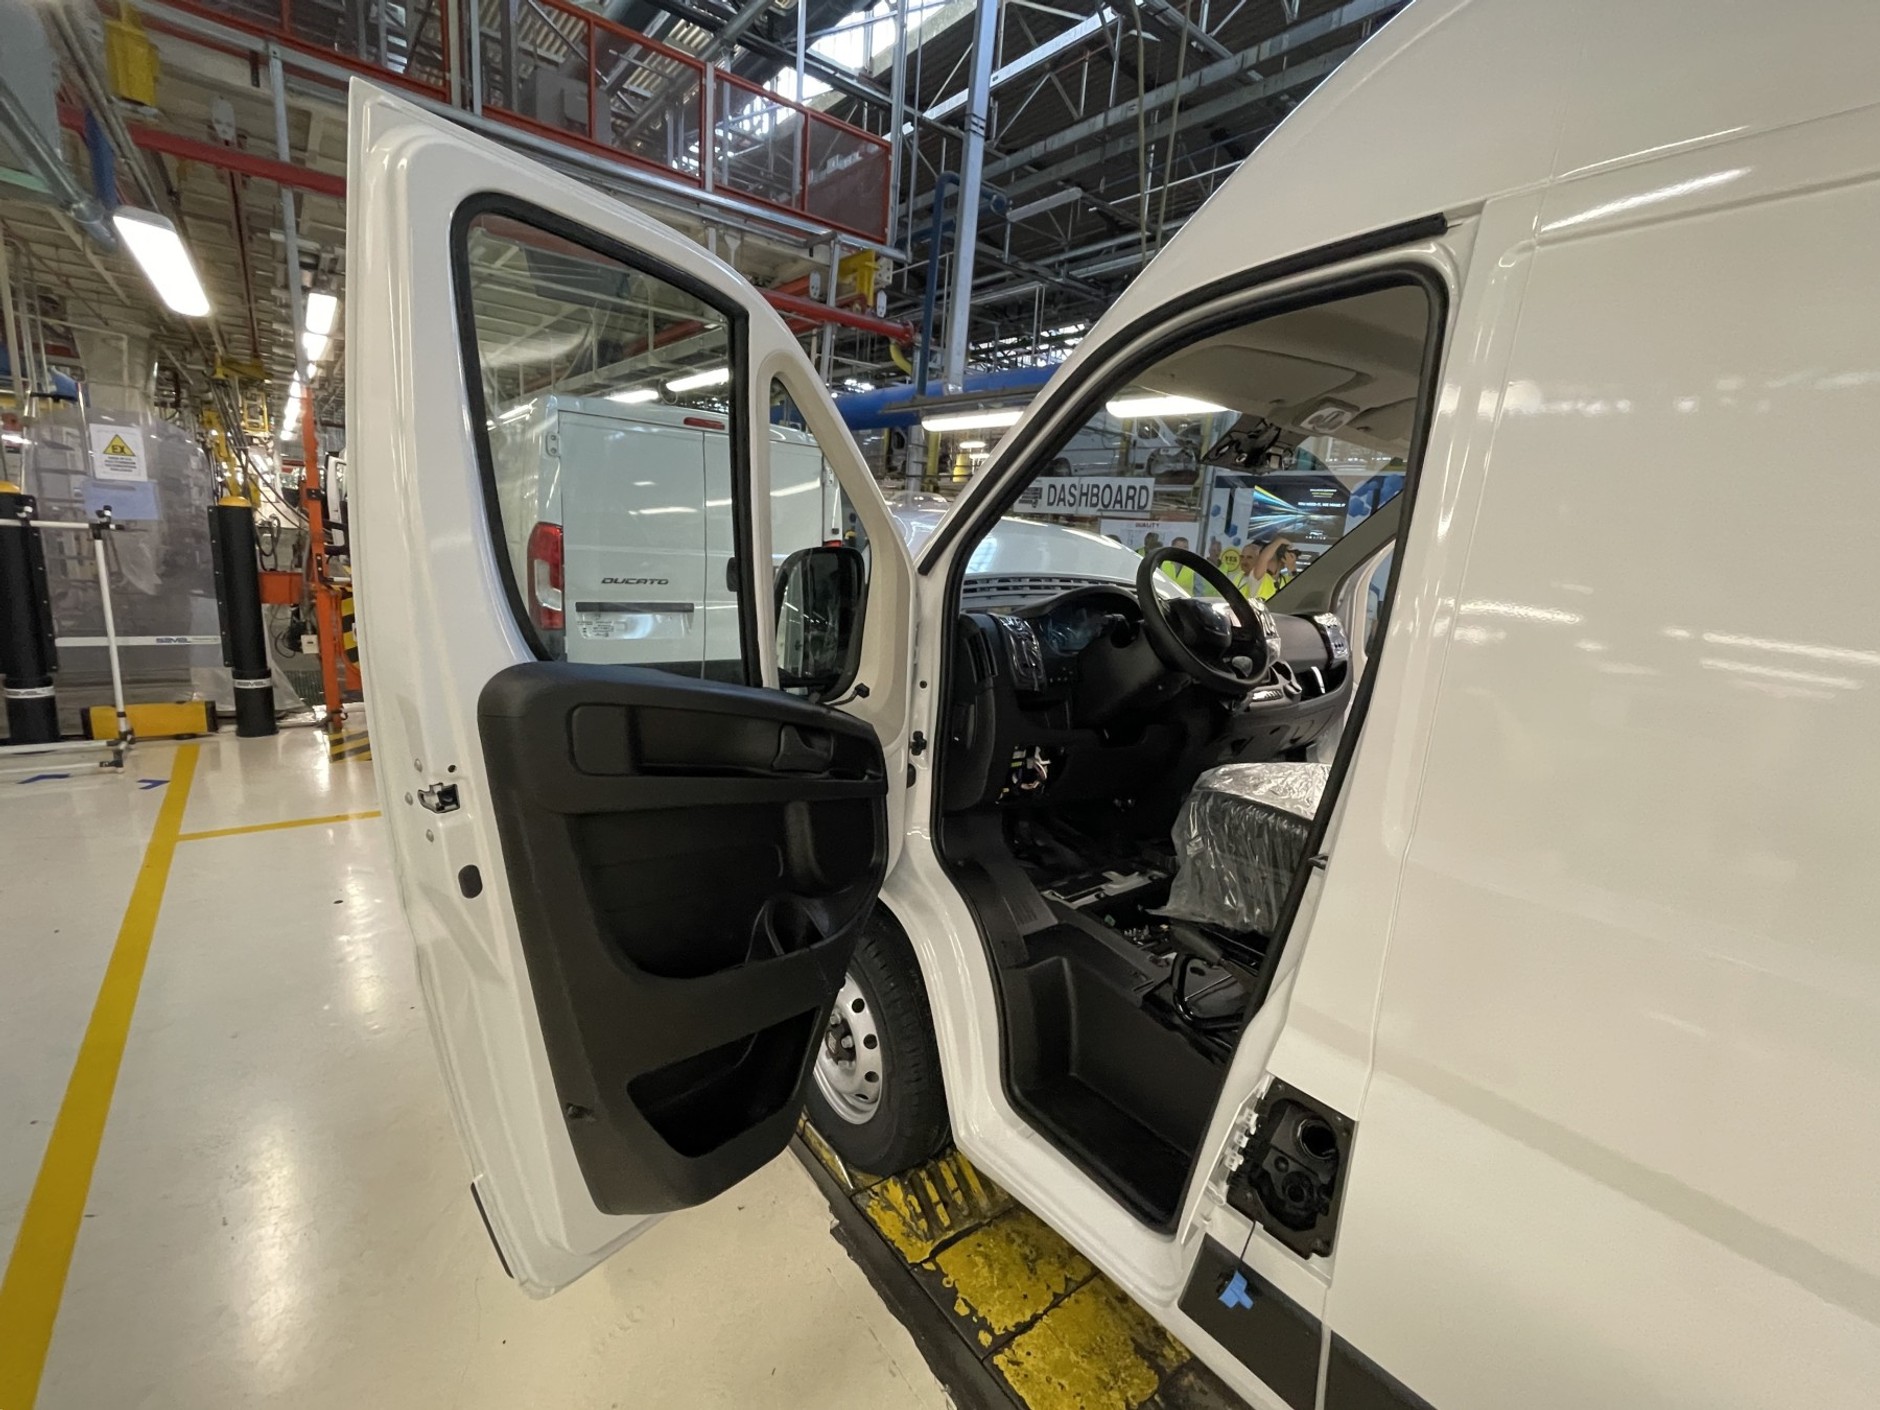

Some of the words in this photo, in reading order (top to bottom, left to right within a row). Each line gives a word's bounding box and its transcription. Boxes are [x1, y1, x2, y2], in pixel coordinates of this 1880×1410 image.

[111, 445, 126, 454] EX
[1047, 483, 1150, 510] DASHBOARD
[601, 577, 669, 585] DUCATO
